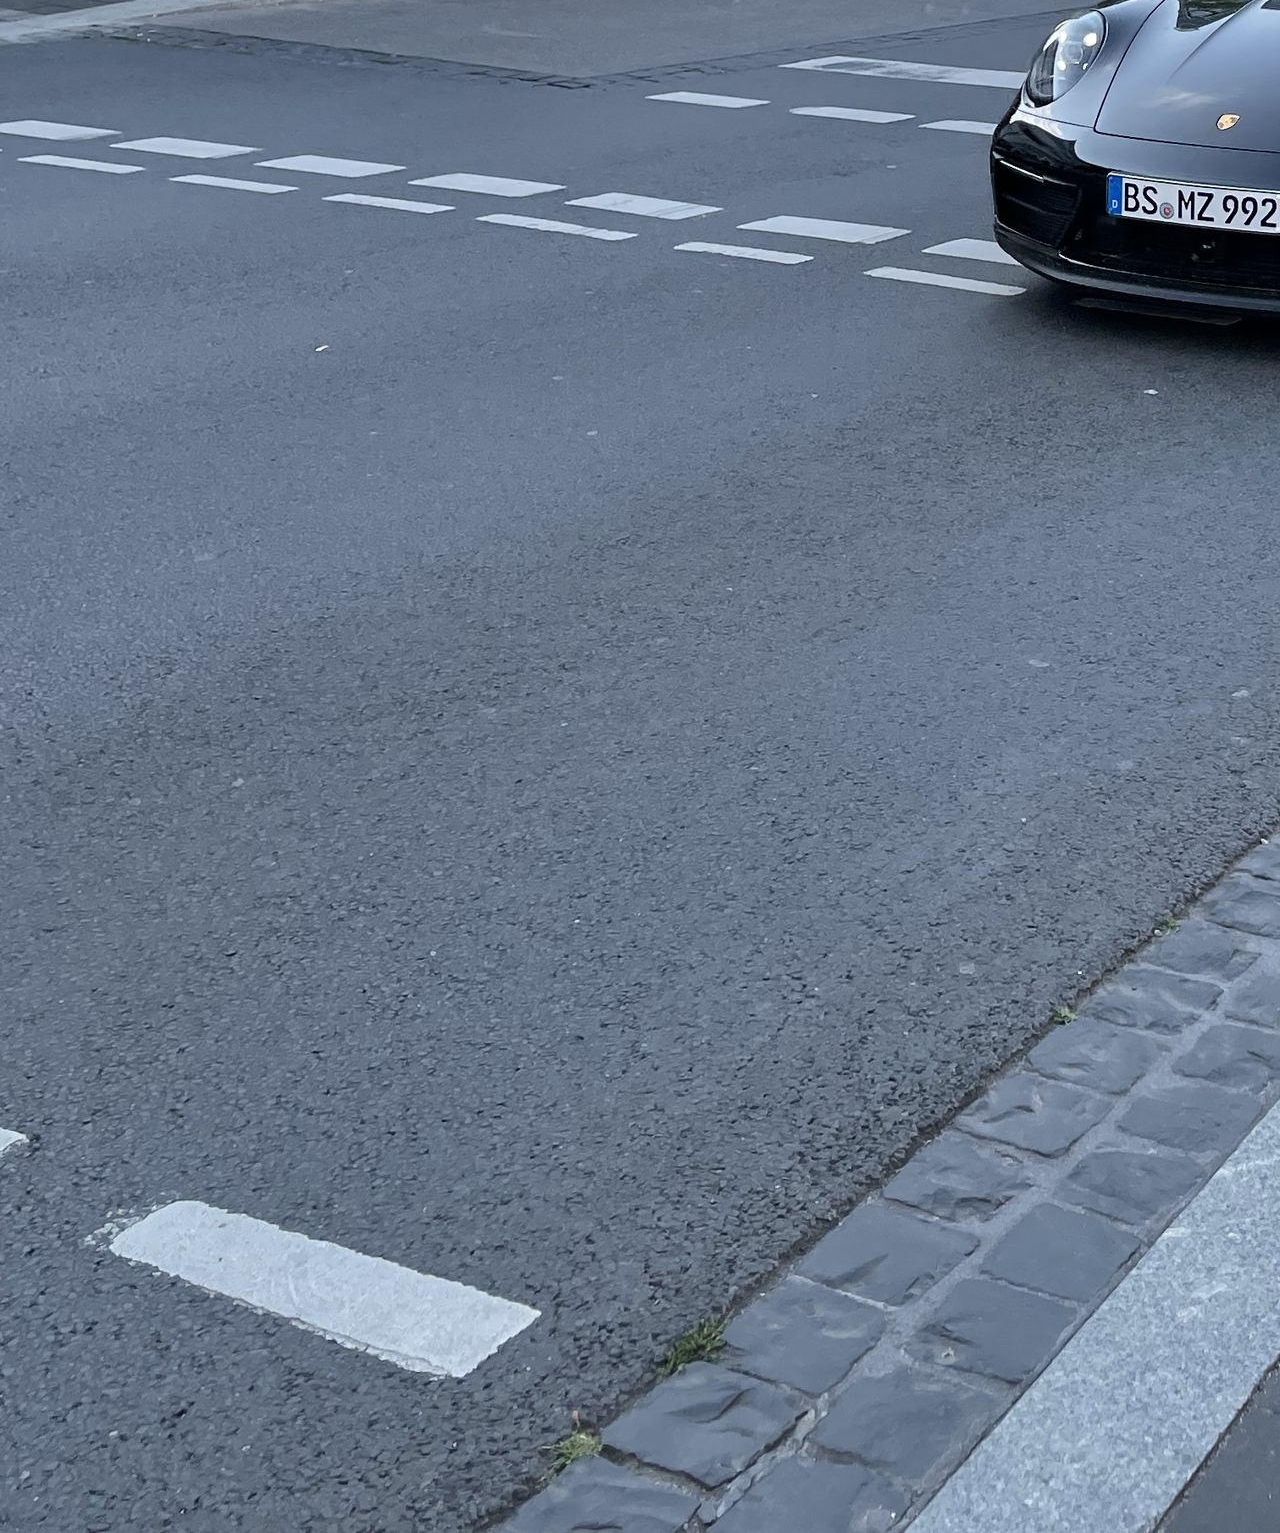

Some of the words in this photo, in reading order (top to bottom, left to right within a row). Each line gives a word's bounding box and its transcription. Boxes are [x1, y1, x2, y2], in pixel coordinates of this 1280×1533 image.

[1111, 199, 1118, 209] D
[1124, 182, 1158, 215] BS
[1177, 189, 1215, 222] MZ
[1222, 194, 1277, 228] 992
